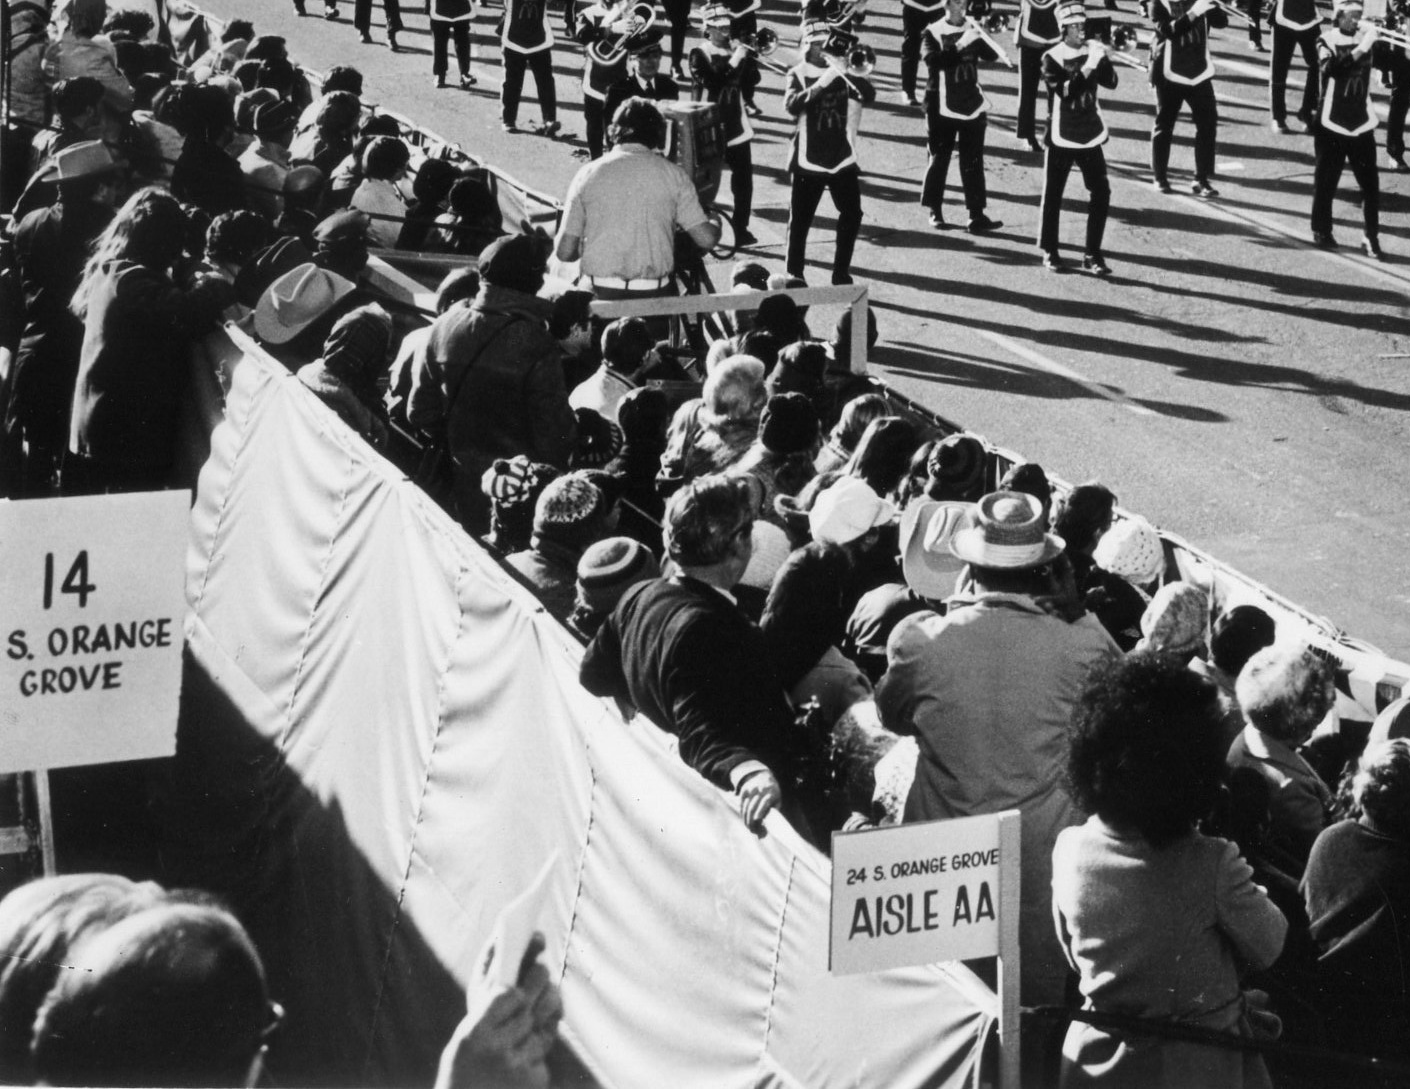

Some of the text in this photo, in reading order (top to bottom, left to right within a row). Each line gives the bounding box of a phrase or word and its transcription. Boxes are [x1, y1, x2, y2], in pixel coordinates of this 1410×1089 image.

[43, 550, 96, 610] 14
[7, 618, 172, 660] S. ORANGE
[19, 662, 123, 697] GROVE
[847, 848, 999, 885] 24 S. ORANGE GROVE
[848, 881, 995, 941] AISLE AA
